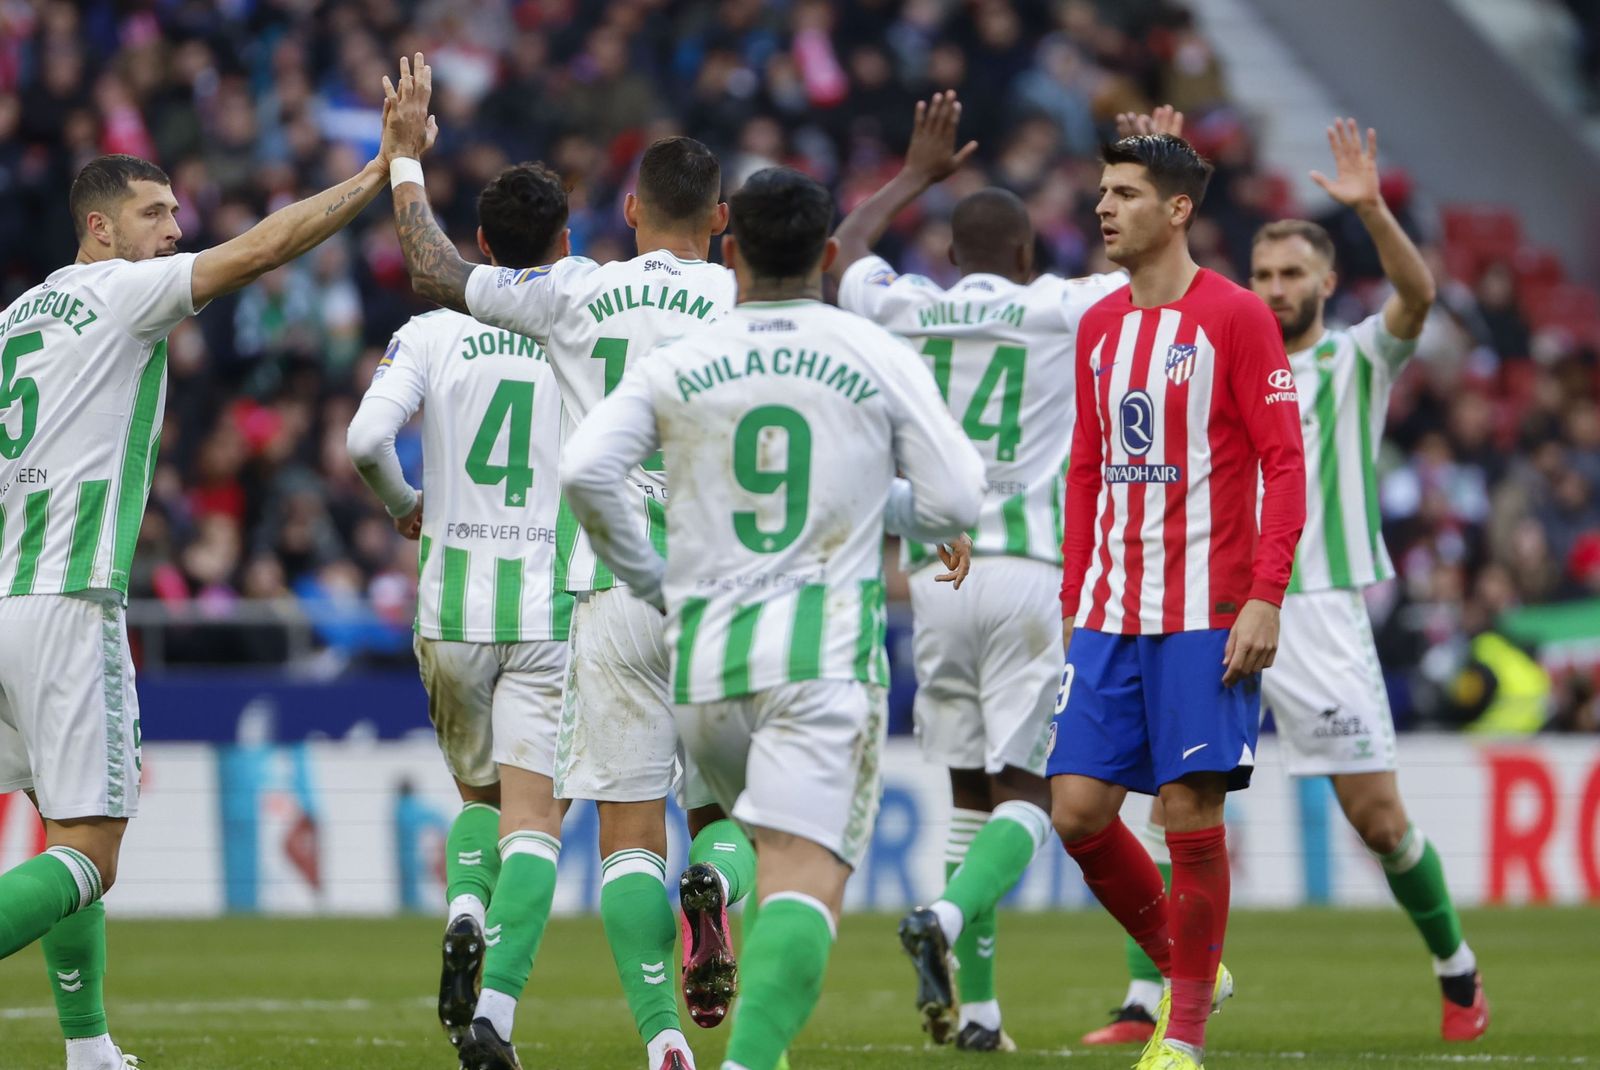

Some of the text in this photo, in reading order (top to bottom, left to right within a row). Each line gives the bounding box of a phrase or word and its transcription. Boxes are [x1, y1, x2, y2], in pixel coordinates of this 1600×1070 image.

[461, 331, 551, 364] JOHN
[0, 330, 44, 460] 5
[920, 336, 1028, 463] 14
[465, 379, 535, 508] 4
[732, 404, 813, 554] 9
[1106, 466, 1178, 482] RIYADH AIR
[526, 527, 556, 544] GRE
[1055, 663, 1075, 715] 9
